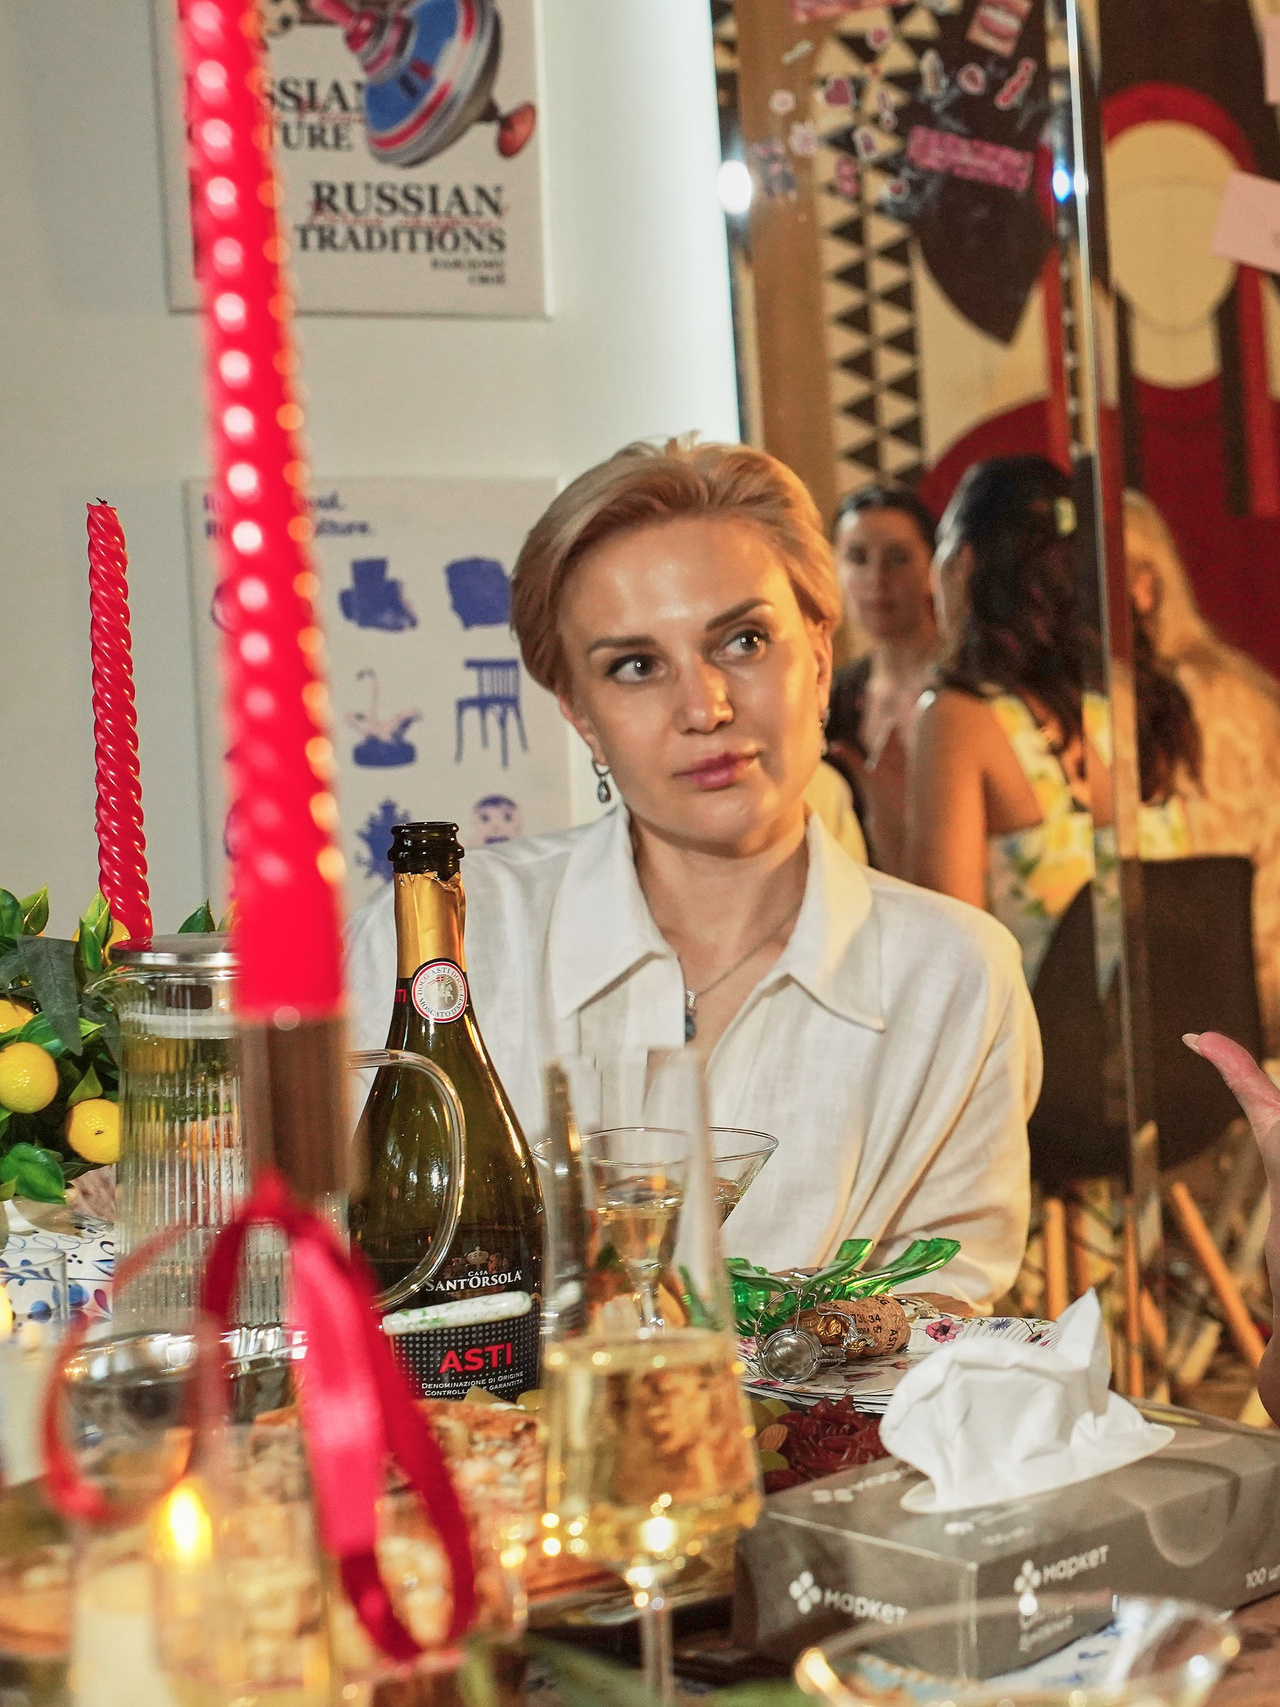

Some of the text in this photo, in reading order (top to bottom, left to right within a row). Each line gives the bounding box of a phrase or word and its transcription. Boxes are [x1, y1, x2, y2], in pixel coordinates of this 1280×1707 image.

[311, 181, 505, 218] RUSSIAN
[294, 223, 506, 253] TRADITIONS
[439, 1342, 512, 1374] ASTI
[1245, 1566, 1267, 1589] 100
